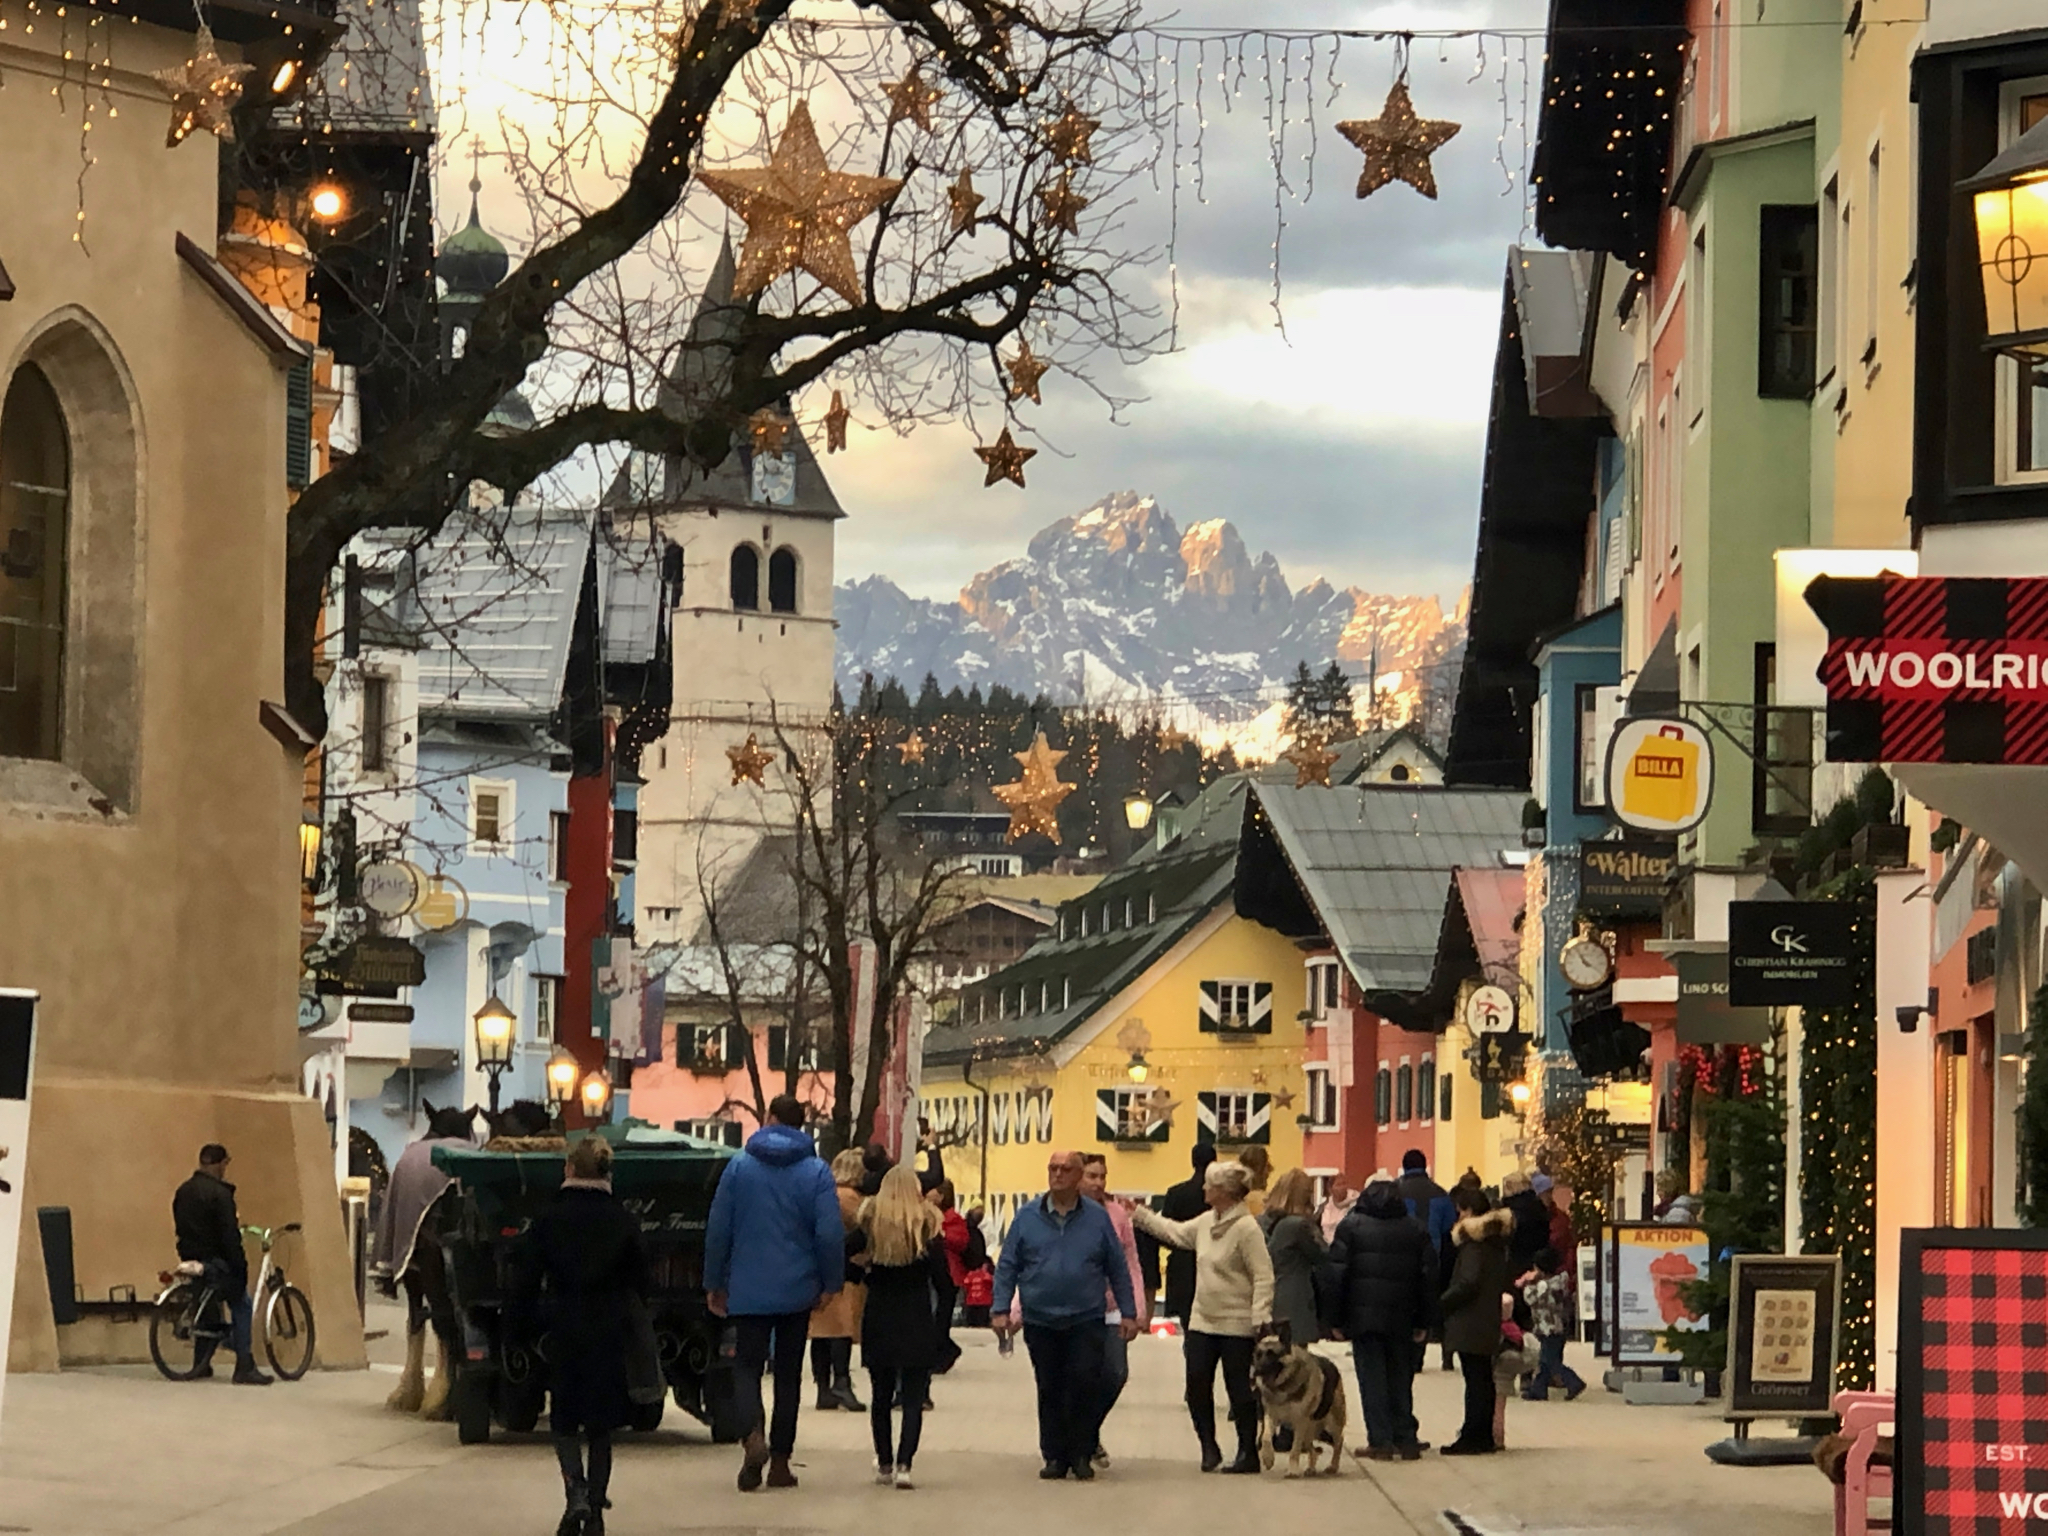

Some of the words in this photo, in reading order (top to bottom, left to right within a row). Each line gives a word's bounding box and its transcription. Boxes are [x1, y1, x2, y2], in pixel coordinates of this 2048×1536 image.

[1845, 651, 2048, 689] WOOLRI
[1637, 758, 1680, 775] BILLA
[1586, 850, 1670, 882] Walter
[1634, 1231, 1693, 1243] AKTION
[1986, 1444, 2032, 1462] EST.
